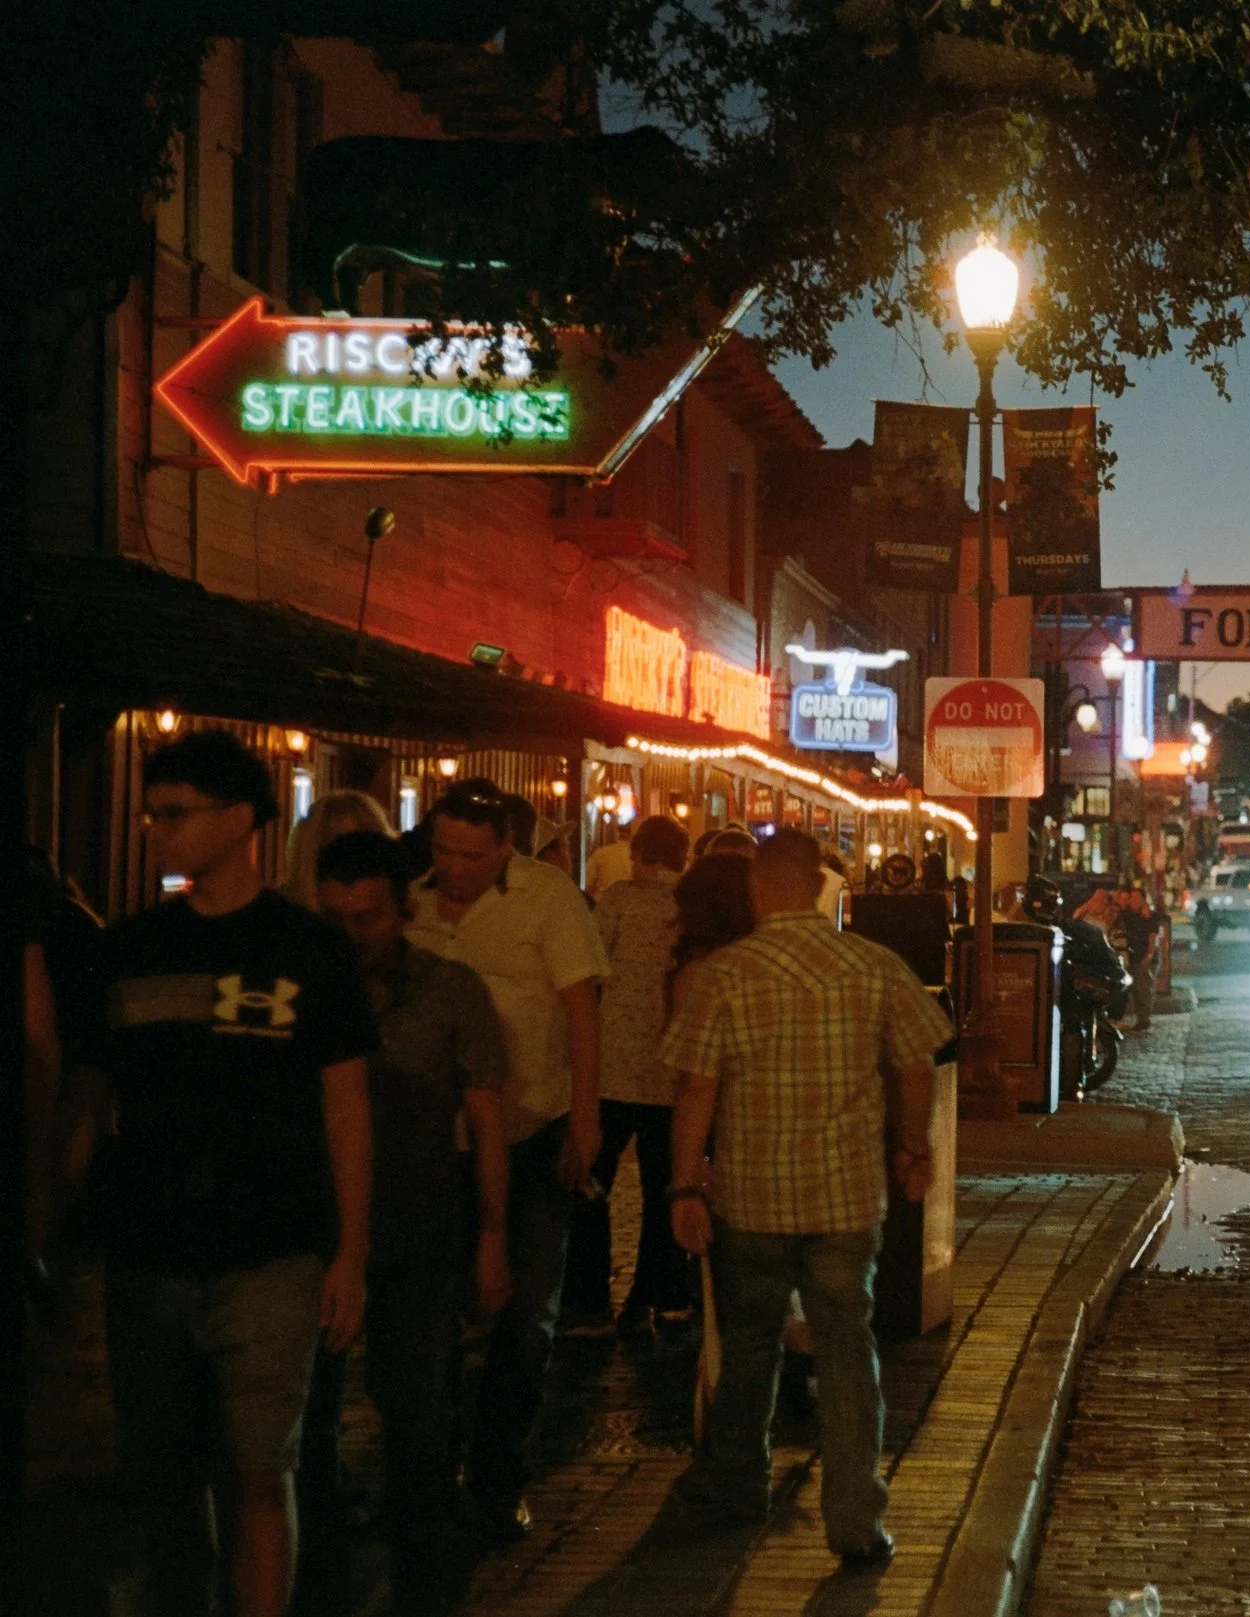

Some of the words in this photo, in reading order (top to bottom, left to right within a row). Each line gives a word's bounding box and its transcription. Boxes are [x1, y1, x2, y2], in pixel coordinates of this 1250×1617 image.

[242, 383, 568, 435] STEAKHOUSE
[1016, 554, 1090, 566] THURSDAYS
[799, 693, 888, 721] CUSTOM
[944, 702, 973, 720] DO
[985, 702, 1026, 720] NOT
[815, 718, 869, 742] HATS
